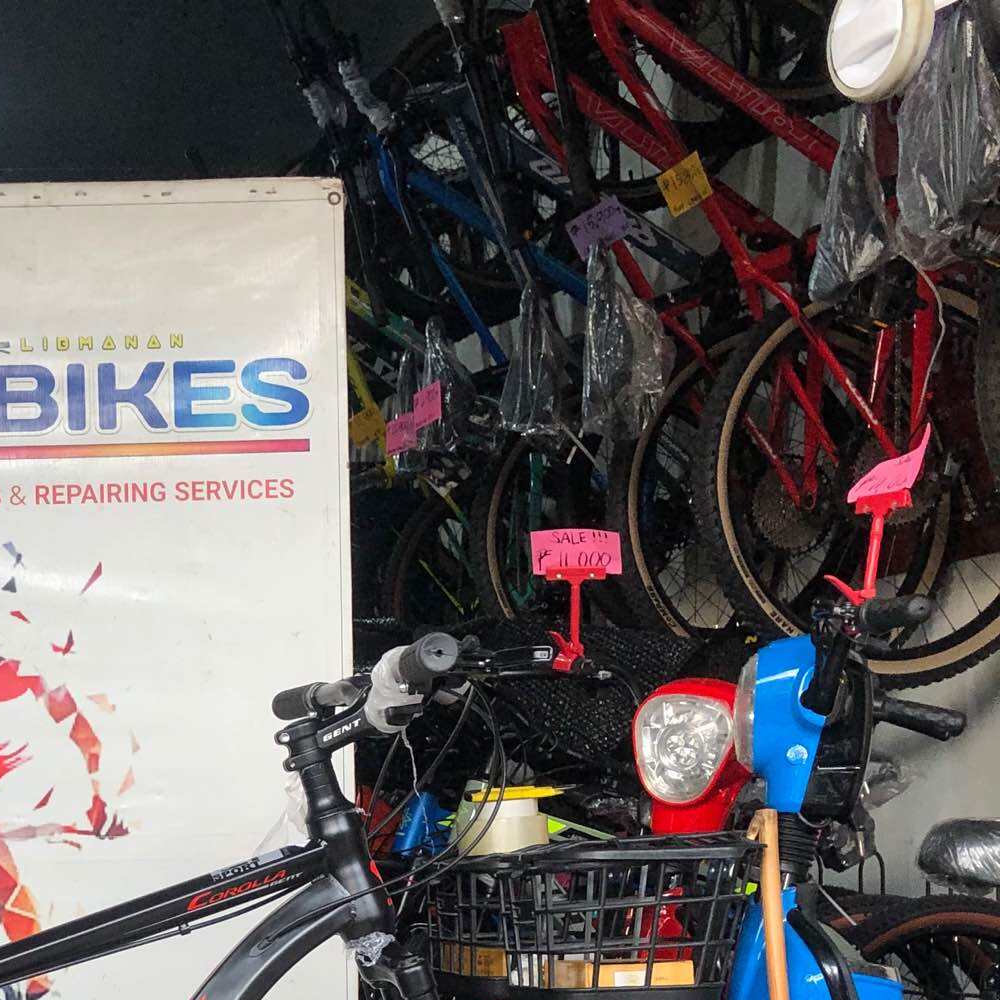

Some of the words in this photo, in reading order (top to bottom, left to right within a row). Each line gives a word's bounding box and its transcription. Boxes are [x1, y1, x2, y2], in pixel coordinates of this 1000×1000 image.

[9, 485, 26, 506] &
[34, 481, 166, 506] REPAIRING
[174, 478, 295, 502] SERVICES
[551, 532, 586, 545] SALE
[321, 717, 362, 743] GENT
